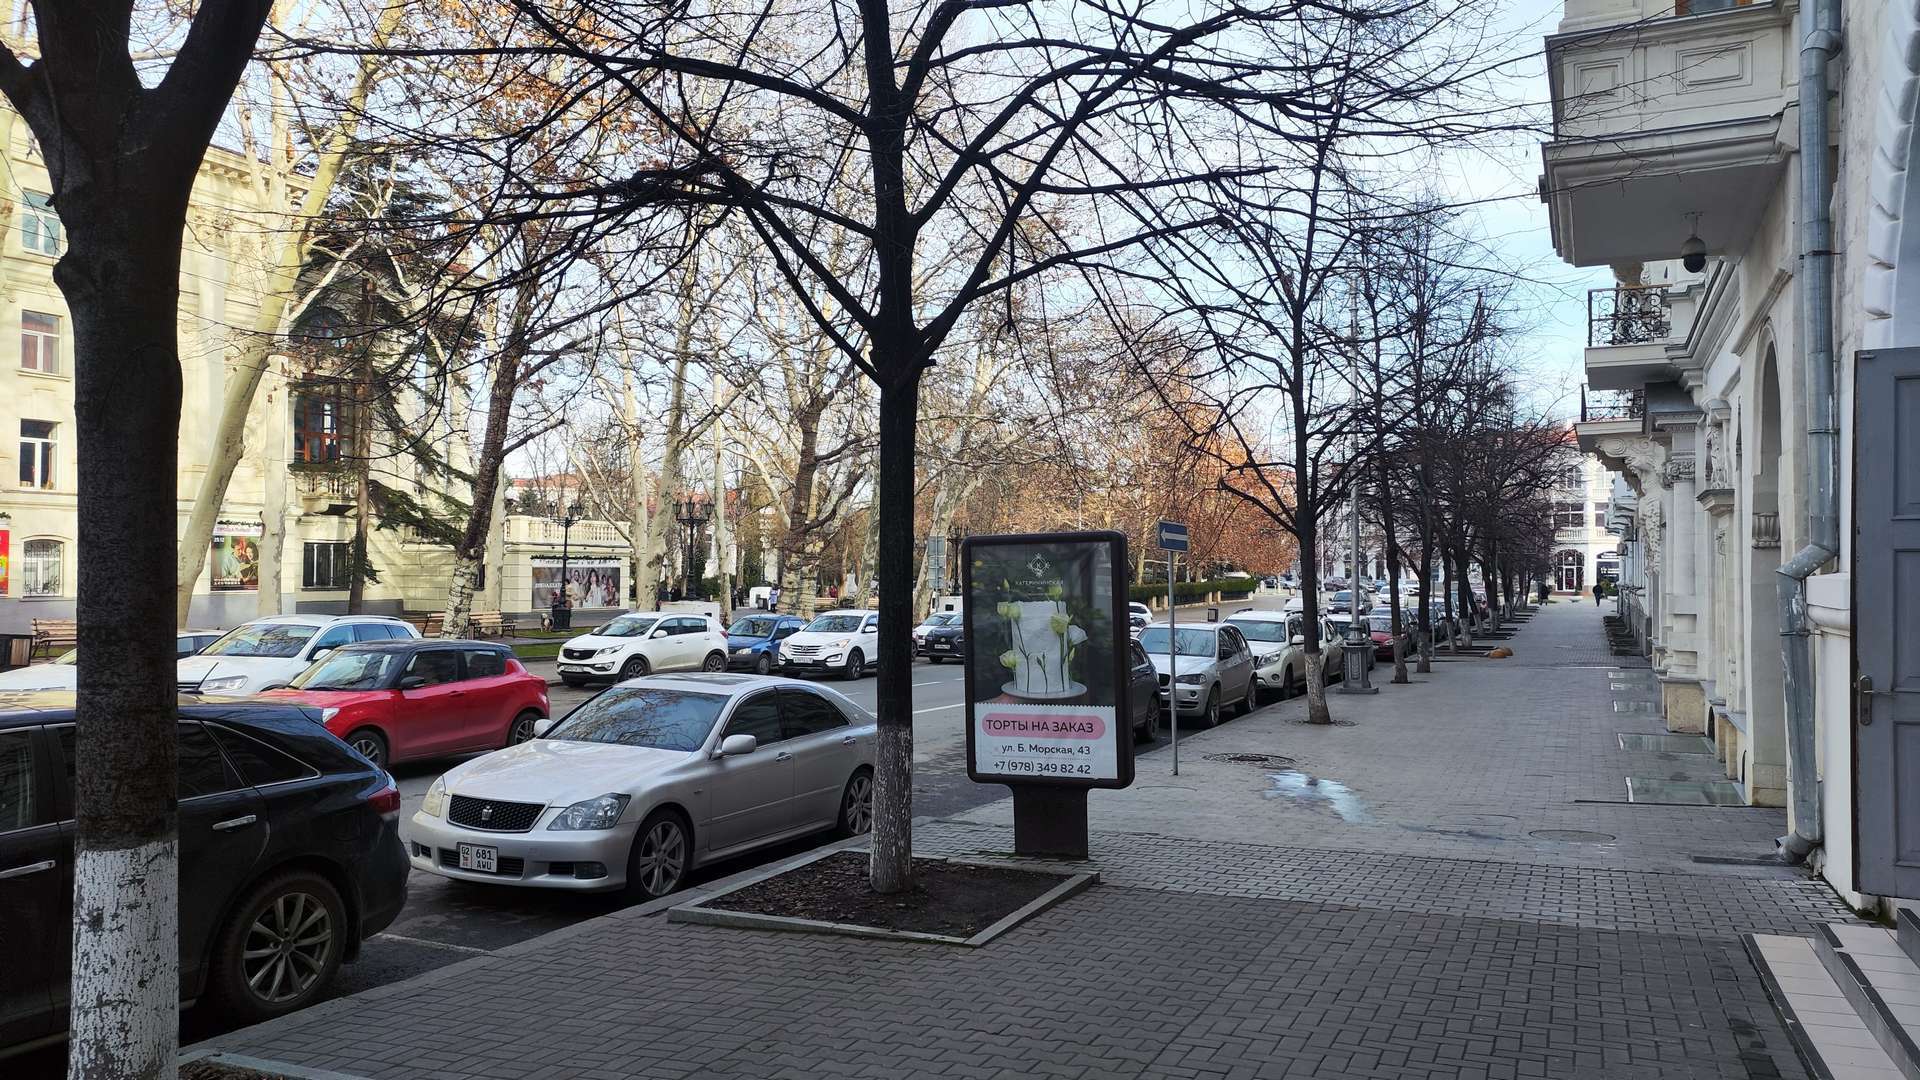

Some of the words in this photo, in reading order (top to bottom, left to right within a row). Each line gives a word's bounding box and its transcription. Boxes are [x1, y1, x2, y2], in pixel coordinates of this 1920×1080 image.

[985, 719, 1028, 731] ТОРТЫ
[1032, 721, 1050, 732] НА
[1052, 721, 1094, 733] ЗАКАЗ
[1001, 744, 1015, 754] ул.
[1018, 743, 1027, 753] Б.
[1029, 744, 1075, 756] Морская,
[1077, 746, 1091, 755] 43
[993, 761, 1006, 770] +7
[1008, 761, 1034, 772] (978)
[1037, 763, 1057, 772] 349
[1060, 764, 1074, 773] 82
[1077, 765, 1091, 774] 42
[475, 849, 495, 861] 681
